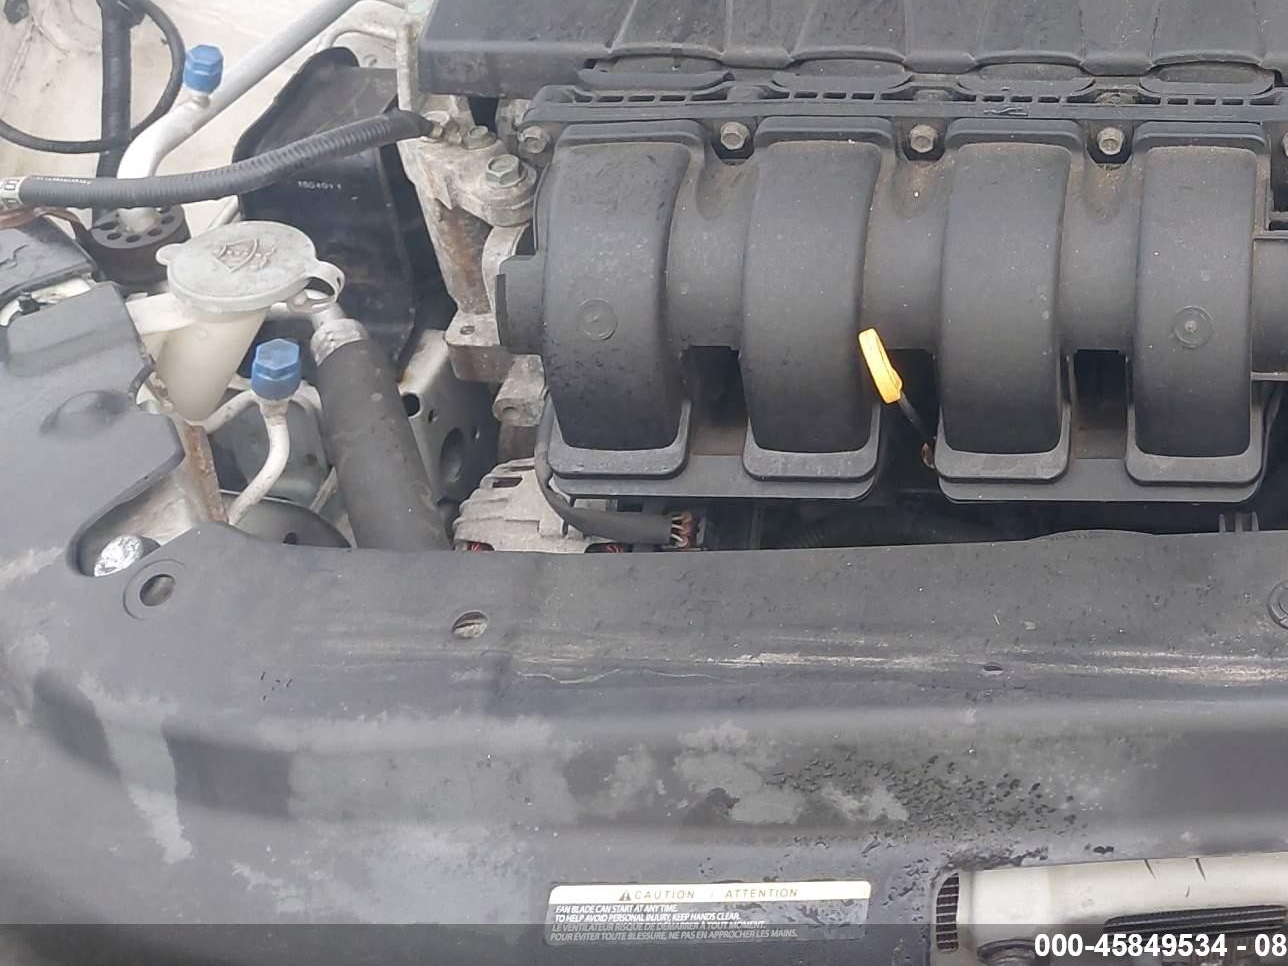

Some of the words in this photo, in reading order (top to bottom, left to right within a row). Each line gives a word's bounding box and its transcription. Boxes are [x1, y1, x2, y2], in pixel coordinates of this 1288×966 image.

[634, 889, 695, 901] CAUTION
[724, 888, 798, 899] ATTENTION
[555, 905, 570, 914] FAN
[571, 905, 595, 914] BLADE
[595, 904, 612, 913] CAN
[611, 904, 634, 913] START
[633, 904, 644, 913] AT
[643, 904, 660, 913] ANY
[555, 914, 565, 923] TO
[565, 914, 584, 923] HELP
[584, 914, 608, 922] AVOID
[608, 914, 646, 922] PERSONAL
[672, 913, 690, 921] KEEP
[690, 913, 716, 921] HANDS
[716, 912, 741, 920] CLEAR.
[552, 923, 563, 932] LE
[563, 923, 614, 932] VENTILATEUR
[614, 922, 643, 932] RISQUE
[643, 922, 656, 931] DE
[706, 921, 729, 930] TOUT
[550, 932, 574, 941] POUR
[601, 931, 627, 940] TOUTE
[668, 931, 681, 940] NE
[680, 931, 696, 940] PAS
[696, 930, 708, 939] EN
[707, 930, 756, 939] APPROCHER
[756, 929, 770, 938] LES
